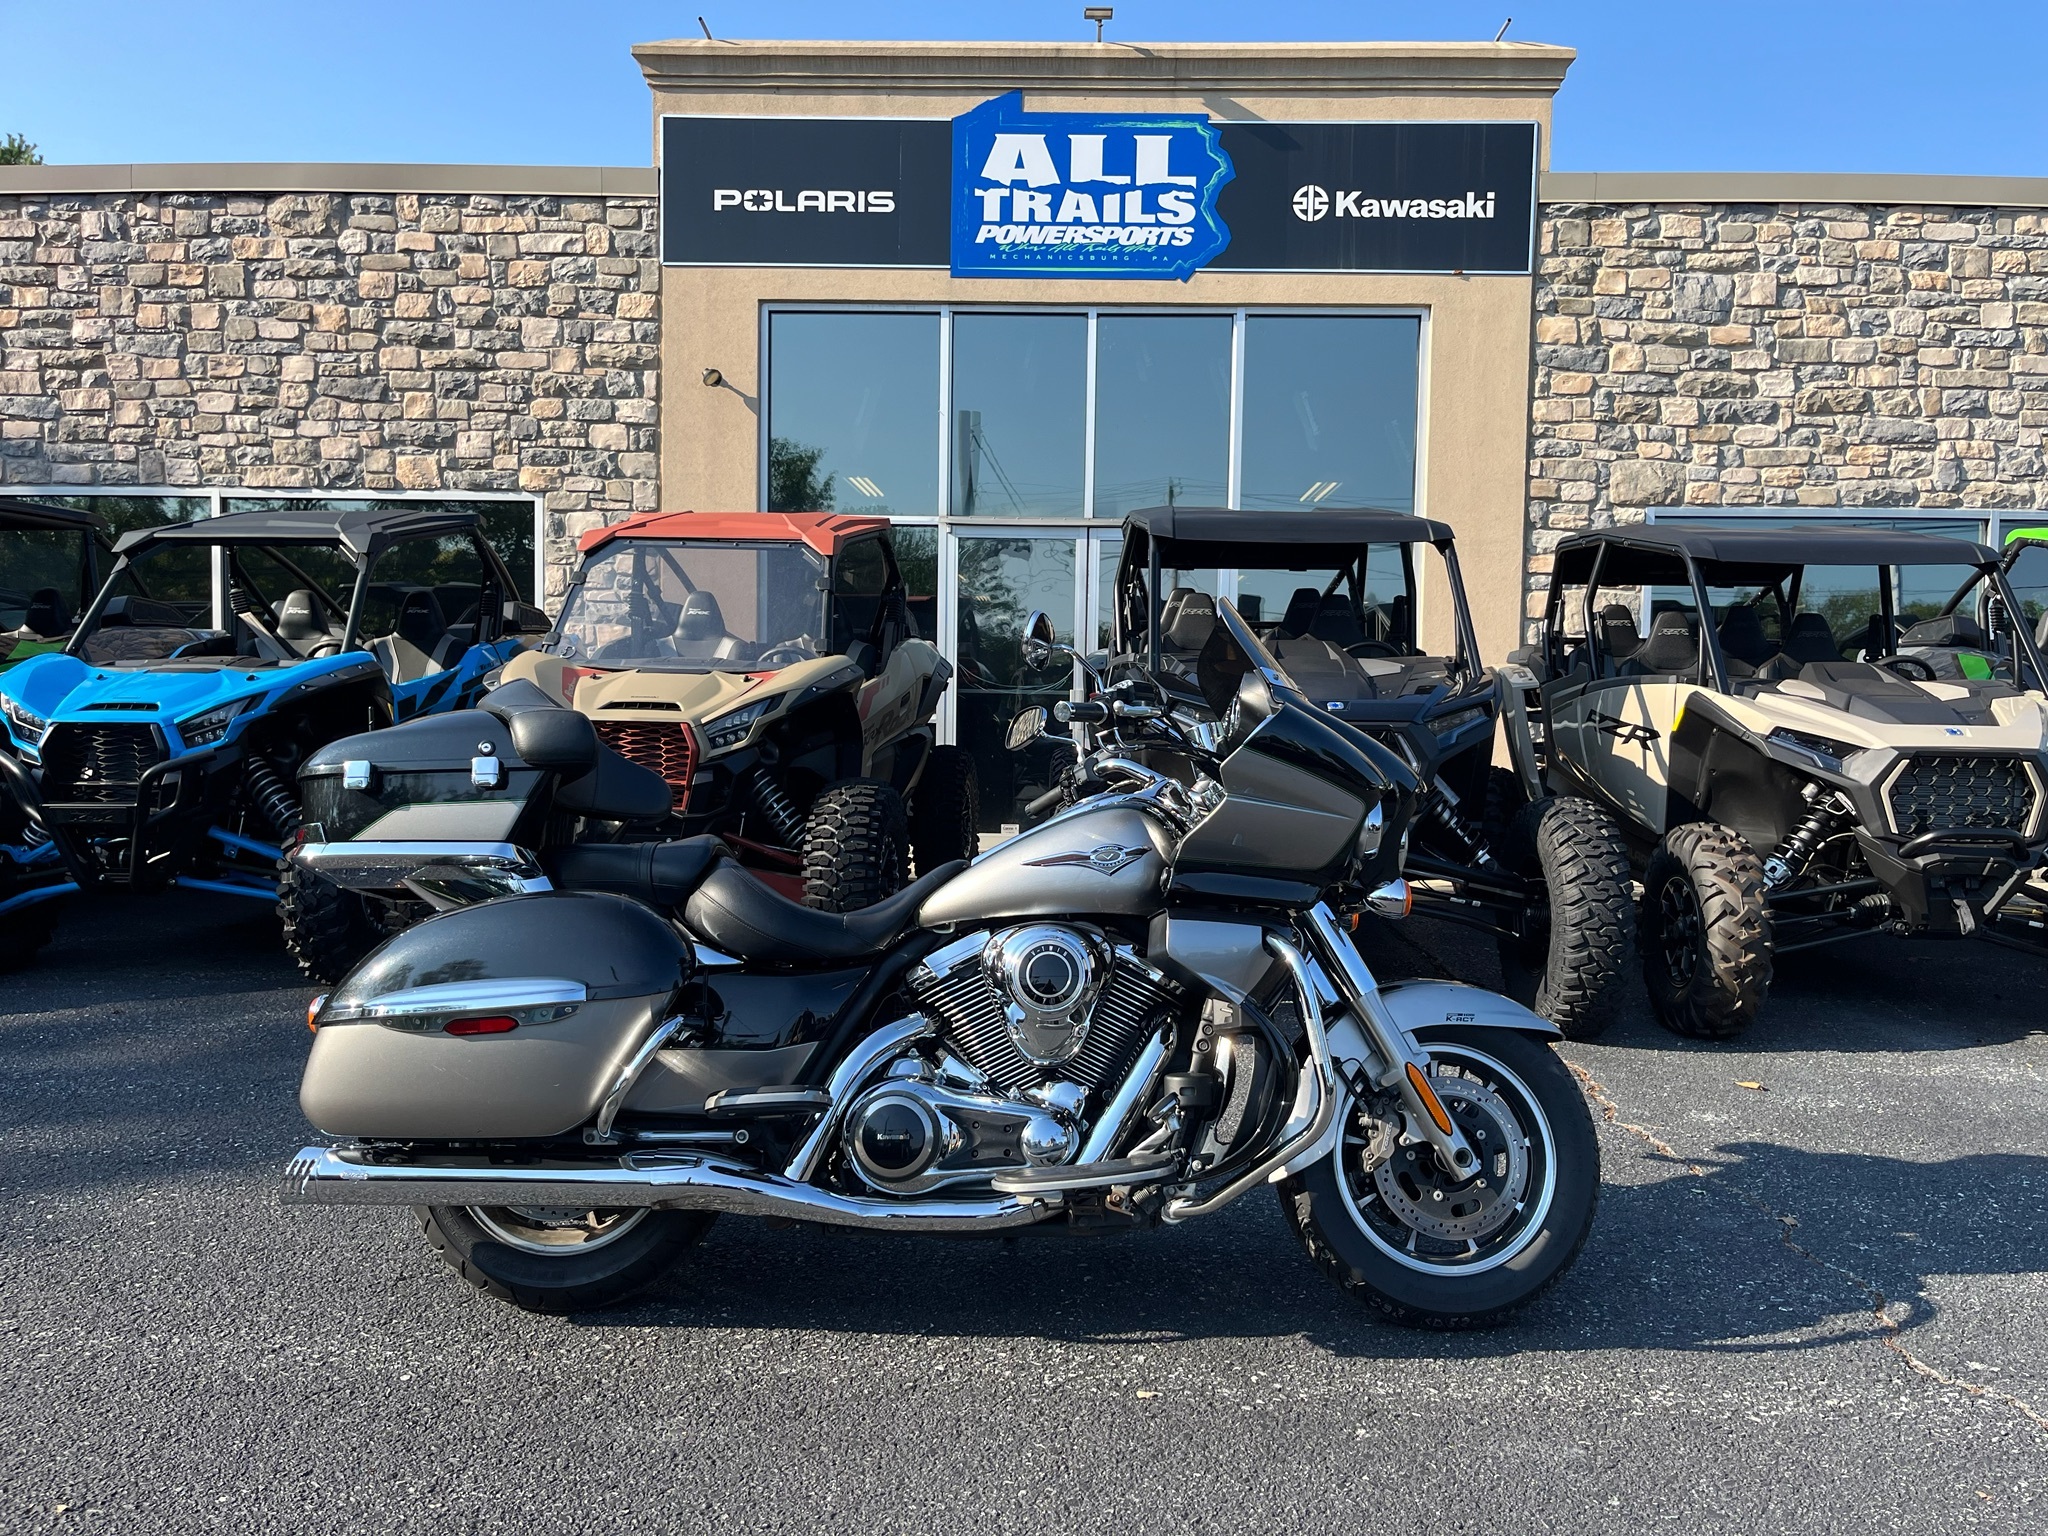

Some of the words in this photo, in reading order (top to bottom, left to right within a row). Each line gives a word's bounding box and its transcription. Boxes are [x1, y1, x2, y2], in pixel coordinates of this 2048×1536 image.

[980, 133, 1197, 189] ALL
[713, 189, 896, 213] POLARIS
[974, 187, 1196, 225] TRAILS
[1335, 190, 1496, 219] Kawasaki
[974, 224, 1195, 247] POWERSPORTS
[1586, 708, 1662, 752] RZR
